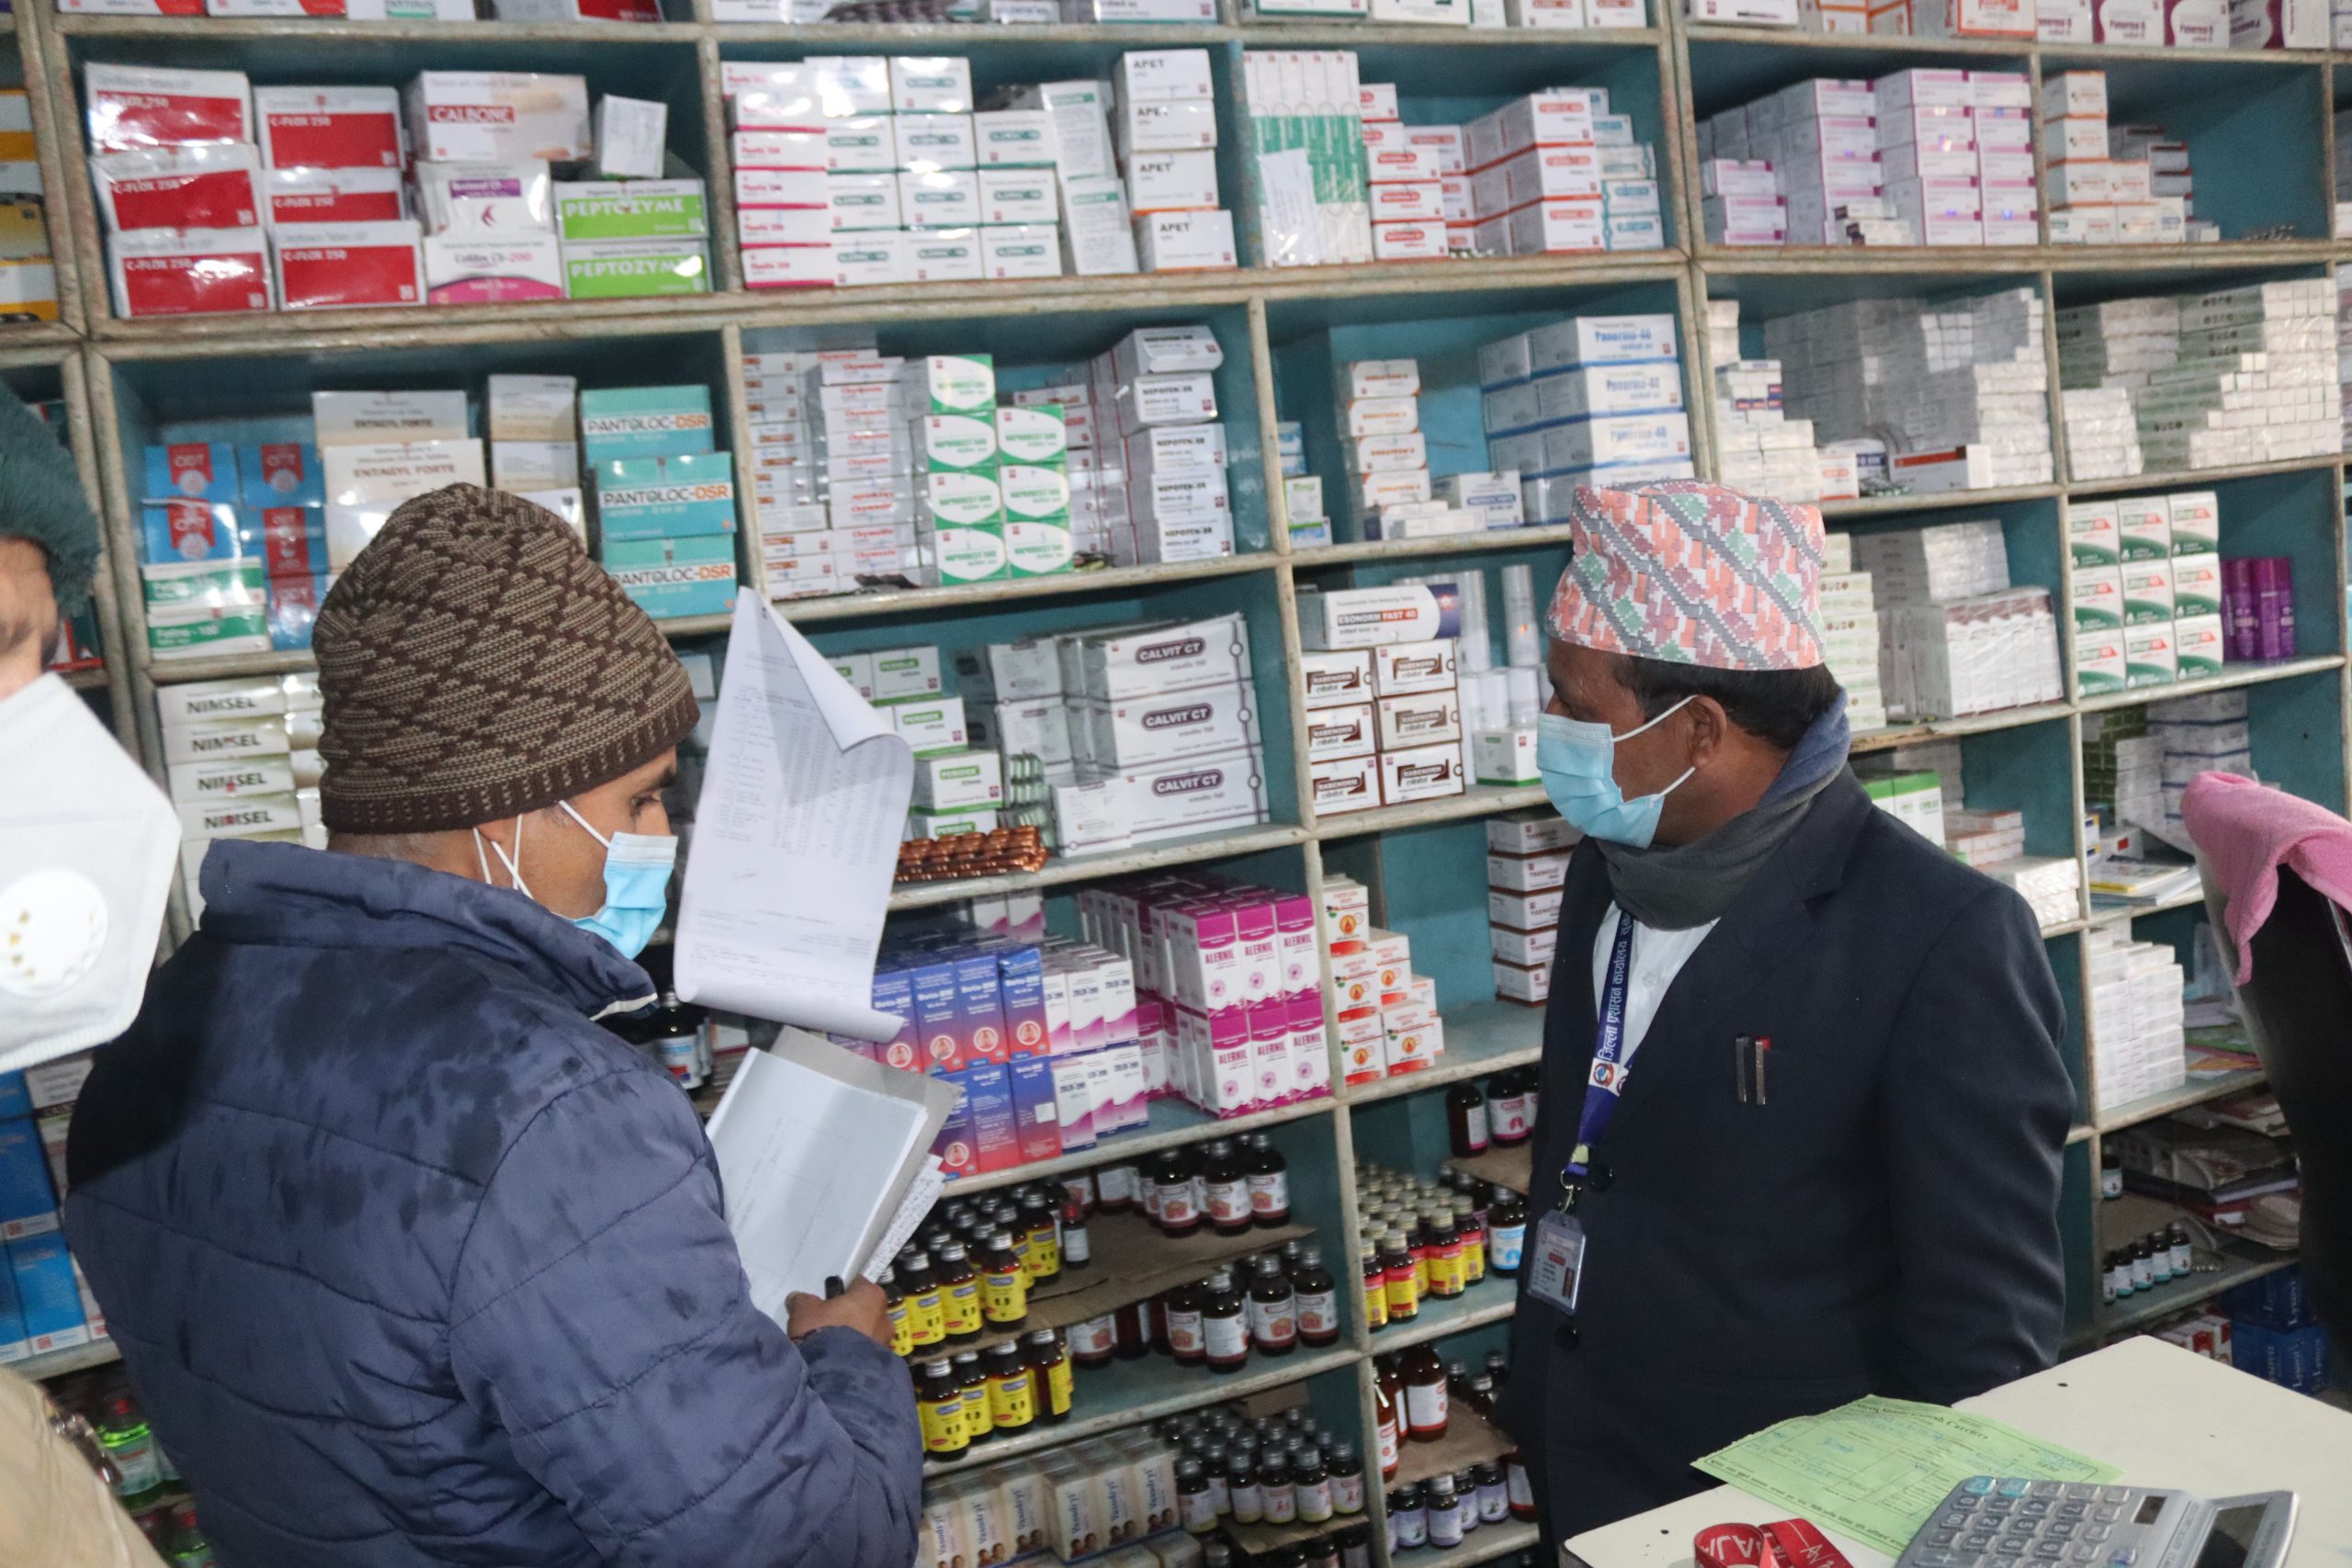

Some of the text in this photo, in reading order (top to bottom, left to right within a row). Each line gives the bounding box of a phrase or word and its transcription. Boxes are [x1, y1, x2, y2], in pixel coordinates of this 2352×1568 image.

[1134, 59, 1164, 69] APET
[1137, 107, 1168, 117] APE
[1140, 164, 1171, 173] APET
[565, 199, 684, 219] PEPTOZYME
[1160, 222, 1190, 232] APET
[571, 259, 696, 277] PEPTOZYM
[588, 415, 709, 434] PANTOLOC-DSR
[603, 486, 729, 507] PANTOLOC-DSR
[1339, 609, 1418, 626] ESONORM FAST 40
[1139, 642, 1202, 662] CALVIT CT
[1313, 671, 1353, 684] RABENORM
[187, 698, 256, 714] NIMSEL
[1145, 707, 1208, 728] CALVIT CT
[1156, 773, 1219, 794] CALVIT CT
[1283, 934, 1313, 947] ALERNIL
[1204, 950, 1235, 964] ALERNIL
[1245, 943, 1273, 956] ALERNIL
[1612, 940, 1628, 985] कार्यालय
[1608, 987, 1623, 1024] प्रशासन
[1294, 1033, 1322, 1047] ALERNIL
[1598, 1024, 1618, 1061] जिल्ला
[1257, 1042, 1285, 1055] ALERNIL
[1219, 1050, 1248, 1065] ALERNIL
